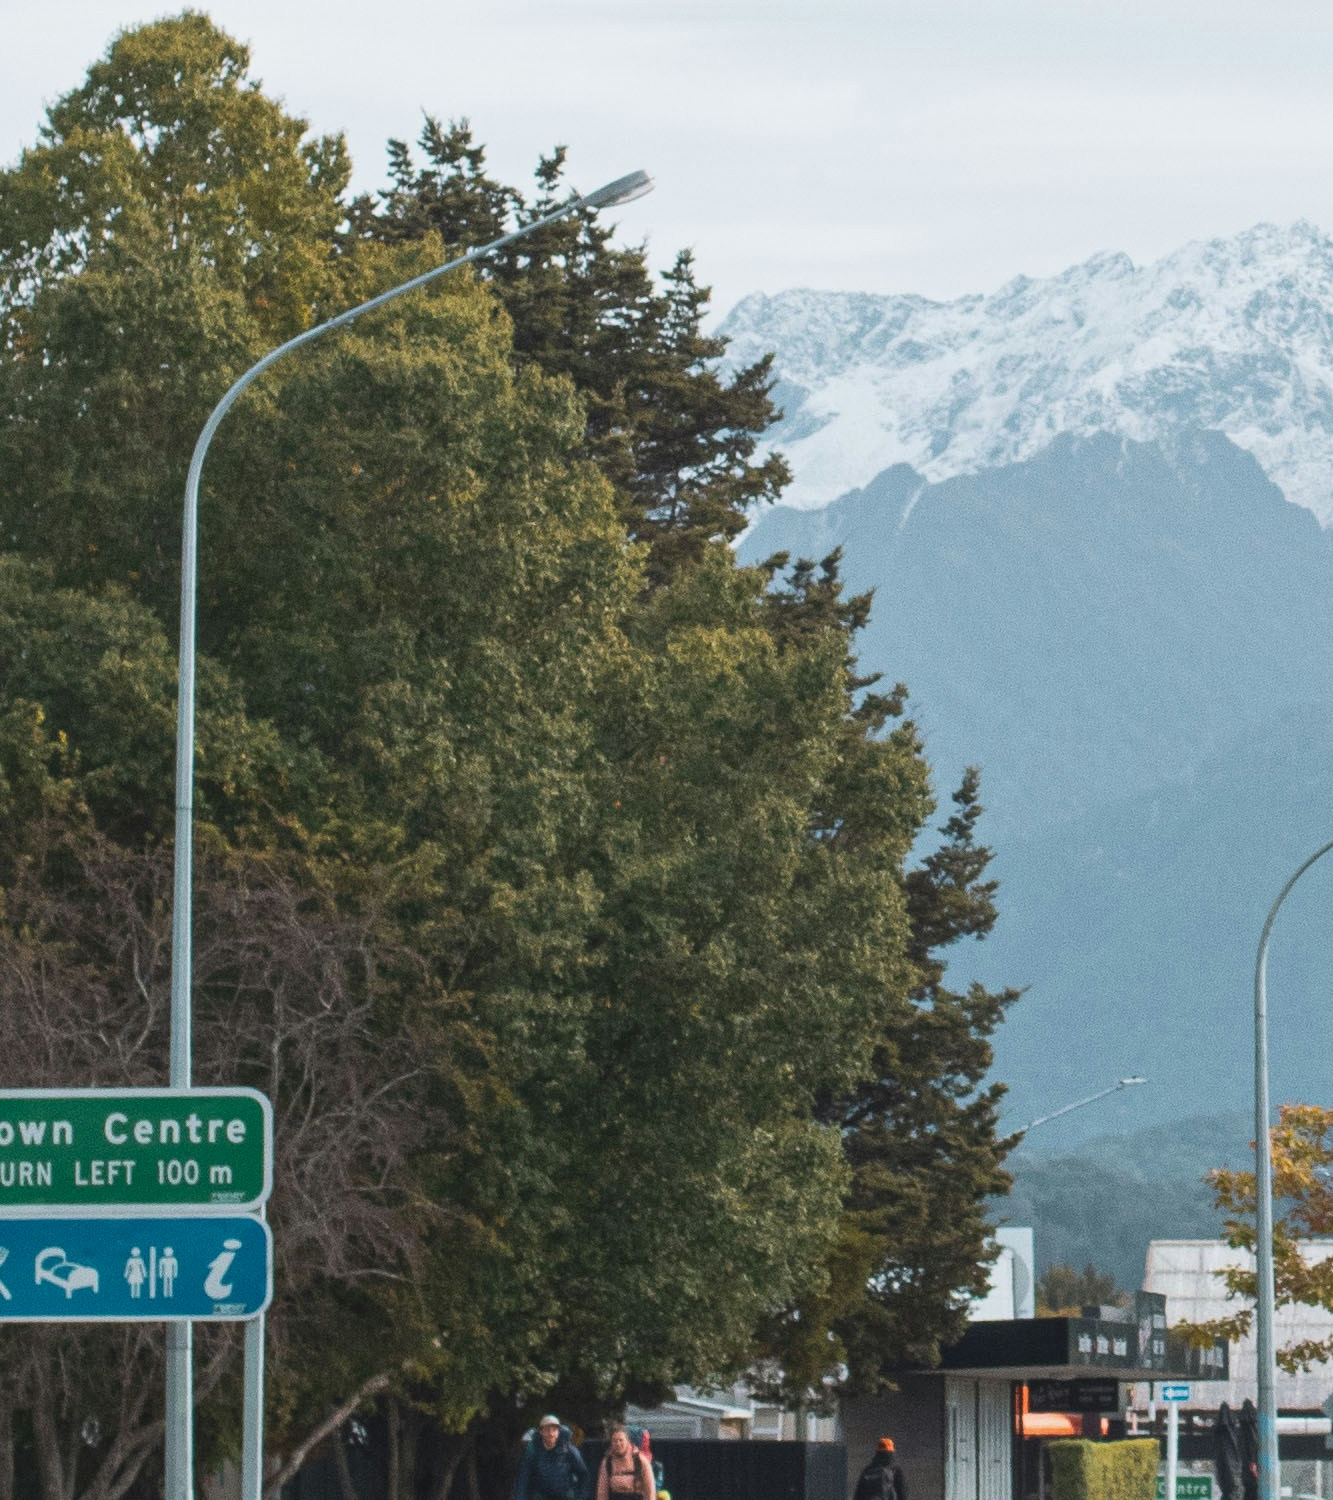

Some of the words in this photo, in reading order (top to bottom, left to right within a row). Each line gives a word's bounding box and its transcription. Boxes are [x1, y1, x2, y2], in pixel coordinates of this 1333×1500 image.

[104, 1112, 246, 1145] Centre
[74, 1160, 136, 1186] LEFT
[158, 1159, 199, 1184] 100
[209, 1165, 232, 1184] m
[1158, 1481, 1208, 1495] Cntre
